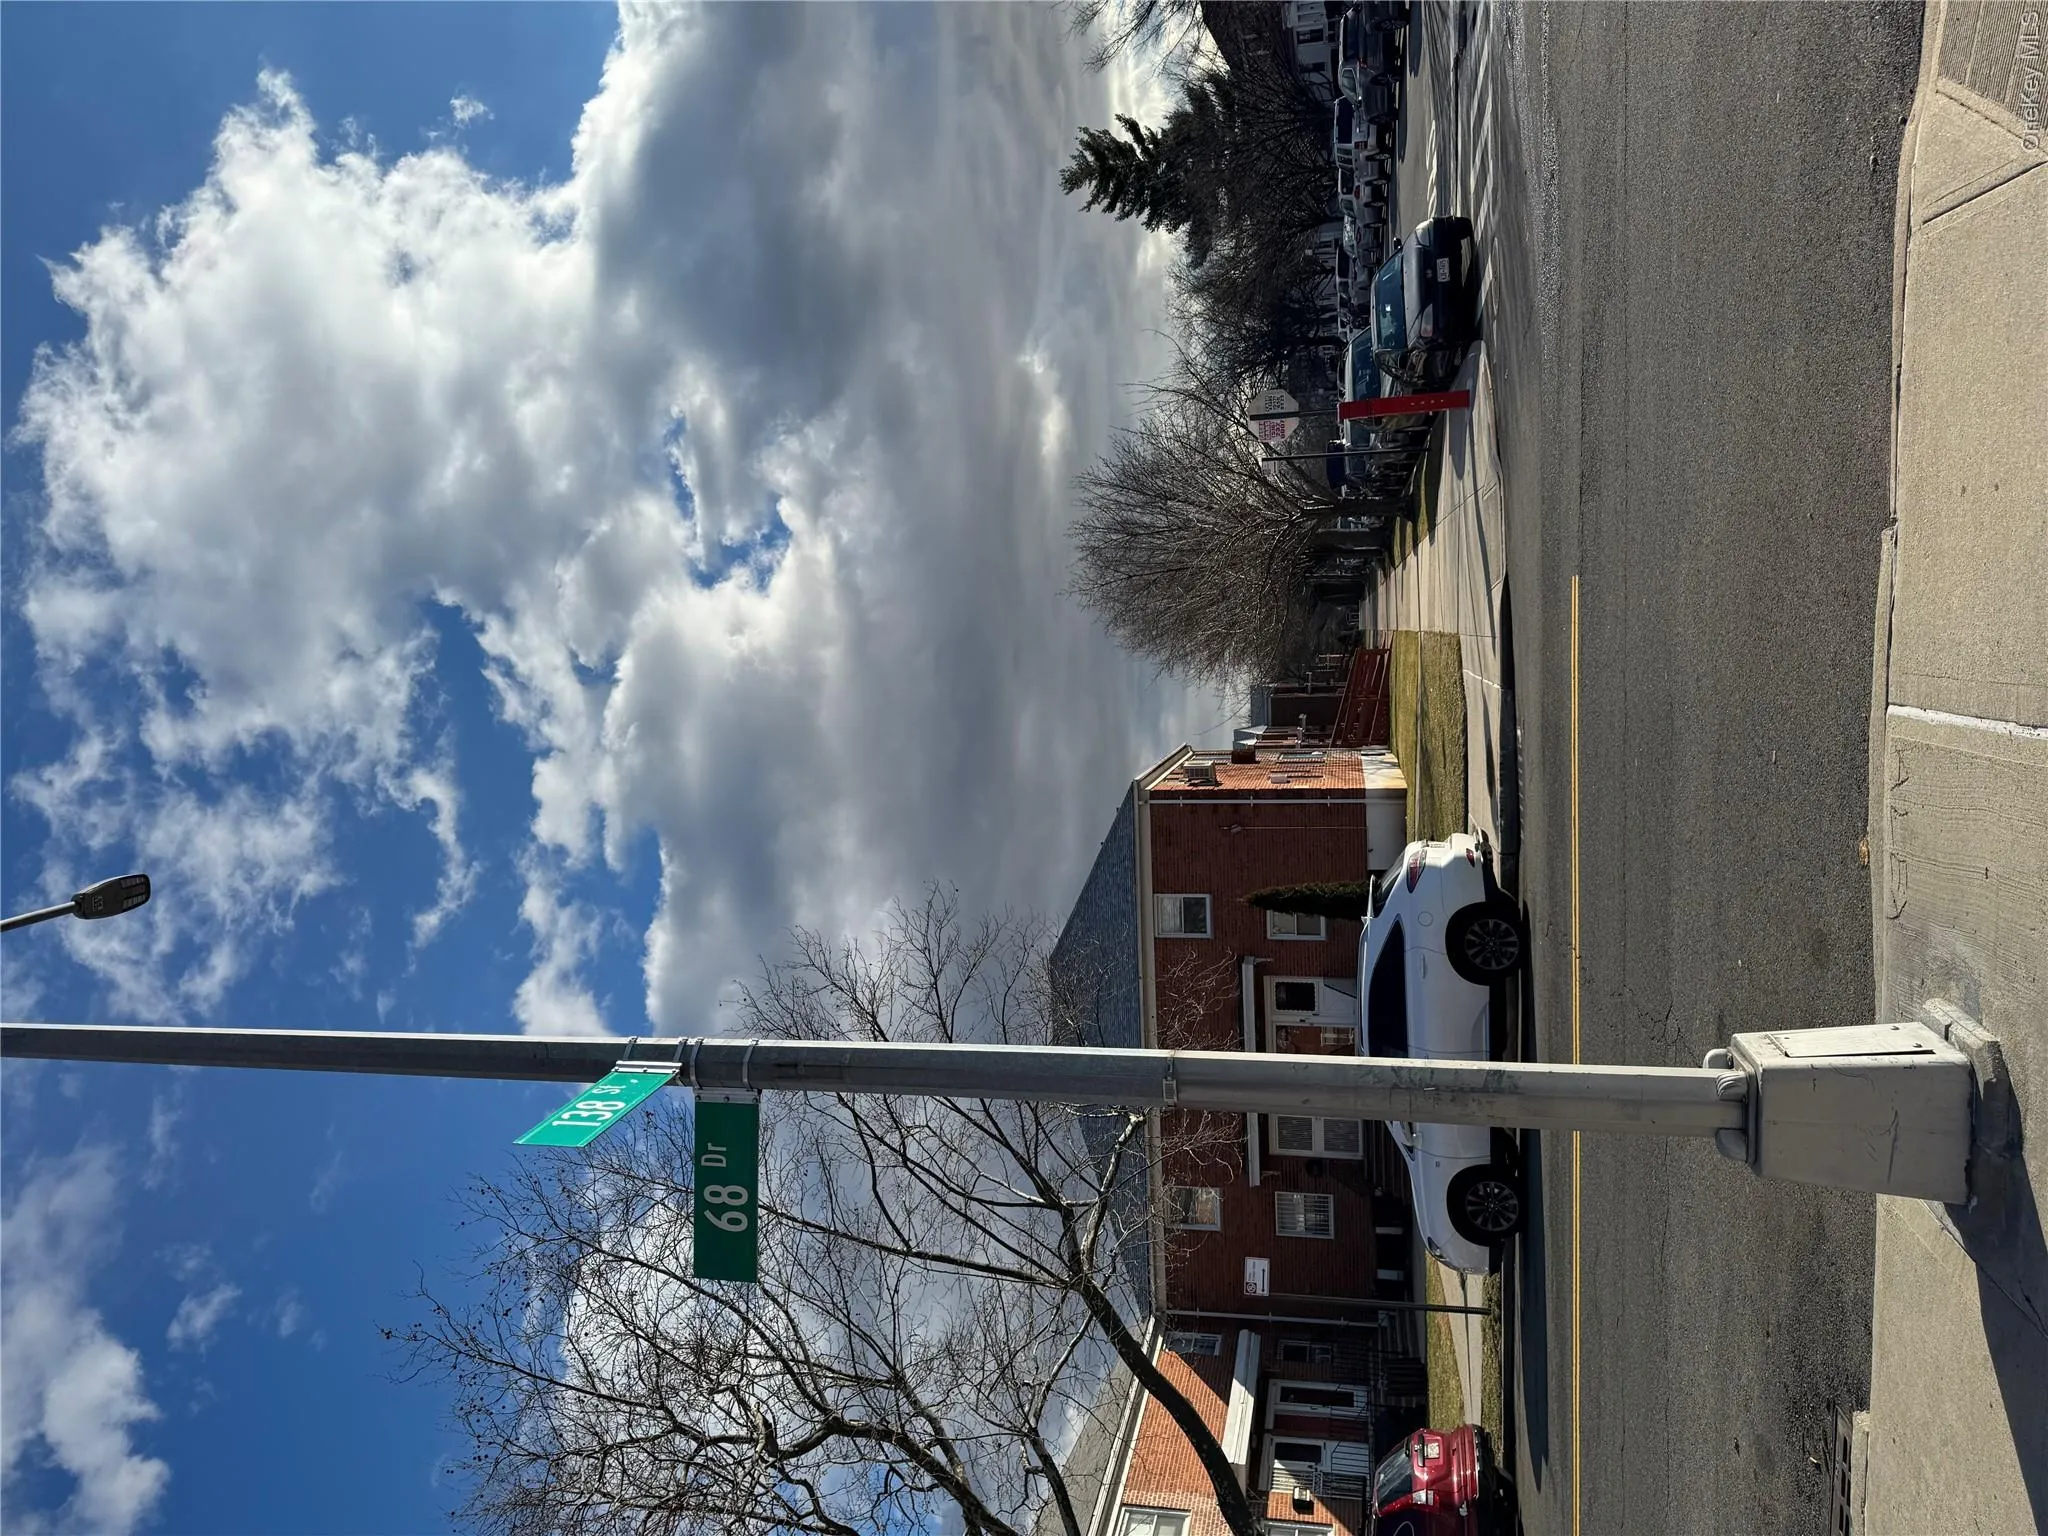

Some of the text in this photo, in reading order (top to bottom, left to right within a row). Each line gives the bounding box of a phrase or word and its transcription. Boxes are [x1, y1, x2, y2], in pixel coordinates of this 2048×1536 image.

[552, 1084, 627, 1128] 138 St
[700, 1142, 749, 1233] 68 Dr
